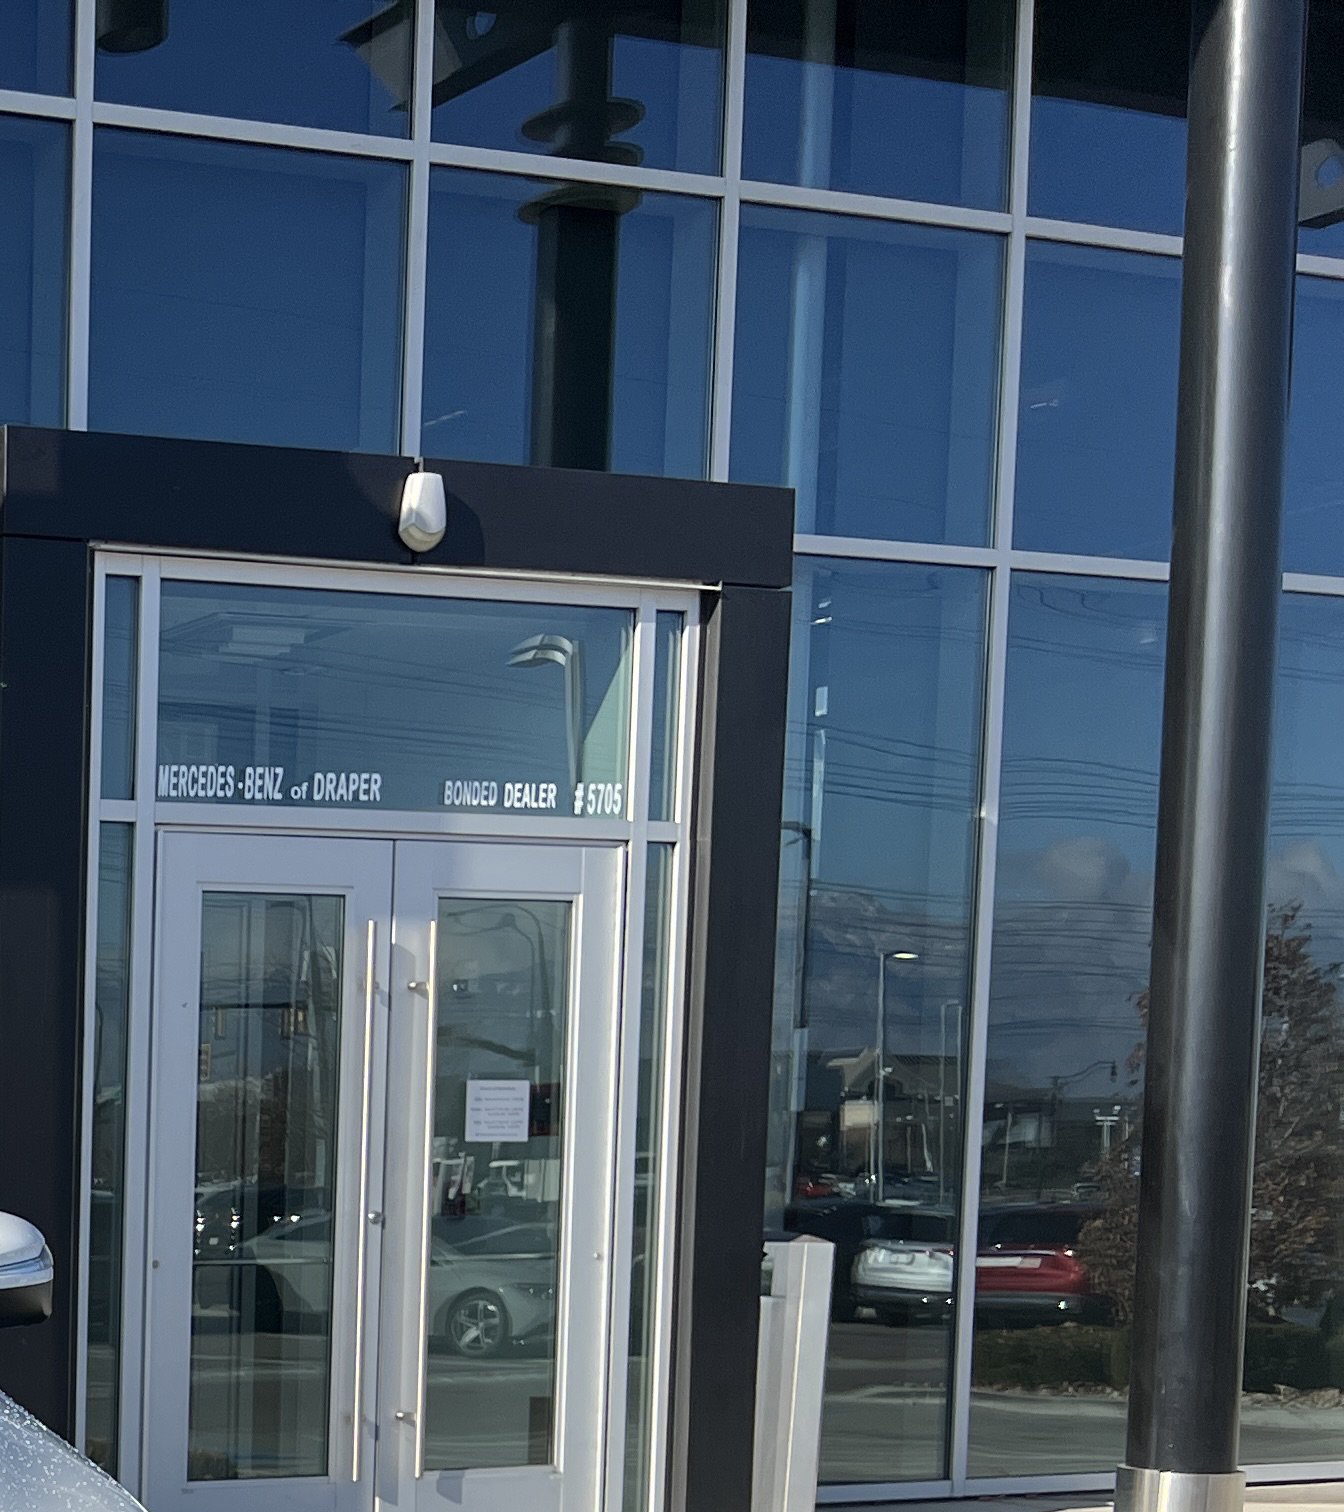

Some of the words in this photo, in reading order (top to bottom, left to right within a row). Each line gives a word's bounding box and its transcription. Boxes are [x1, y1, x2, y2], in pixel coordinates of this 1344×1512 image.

[290, 781, 309, 799] of
[313, 772, 382, 802] DRAPER
[444, 780, 498, 807] BONDED
[504, 782, 557, 809] DEALER
